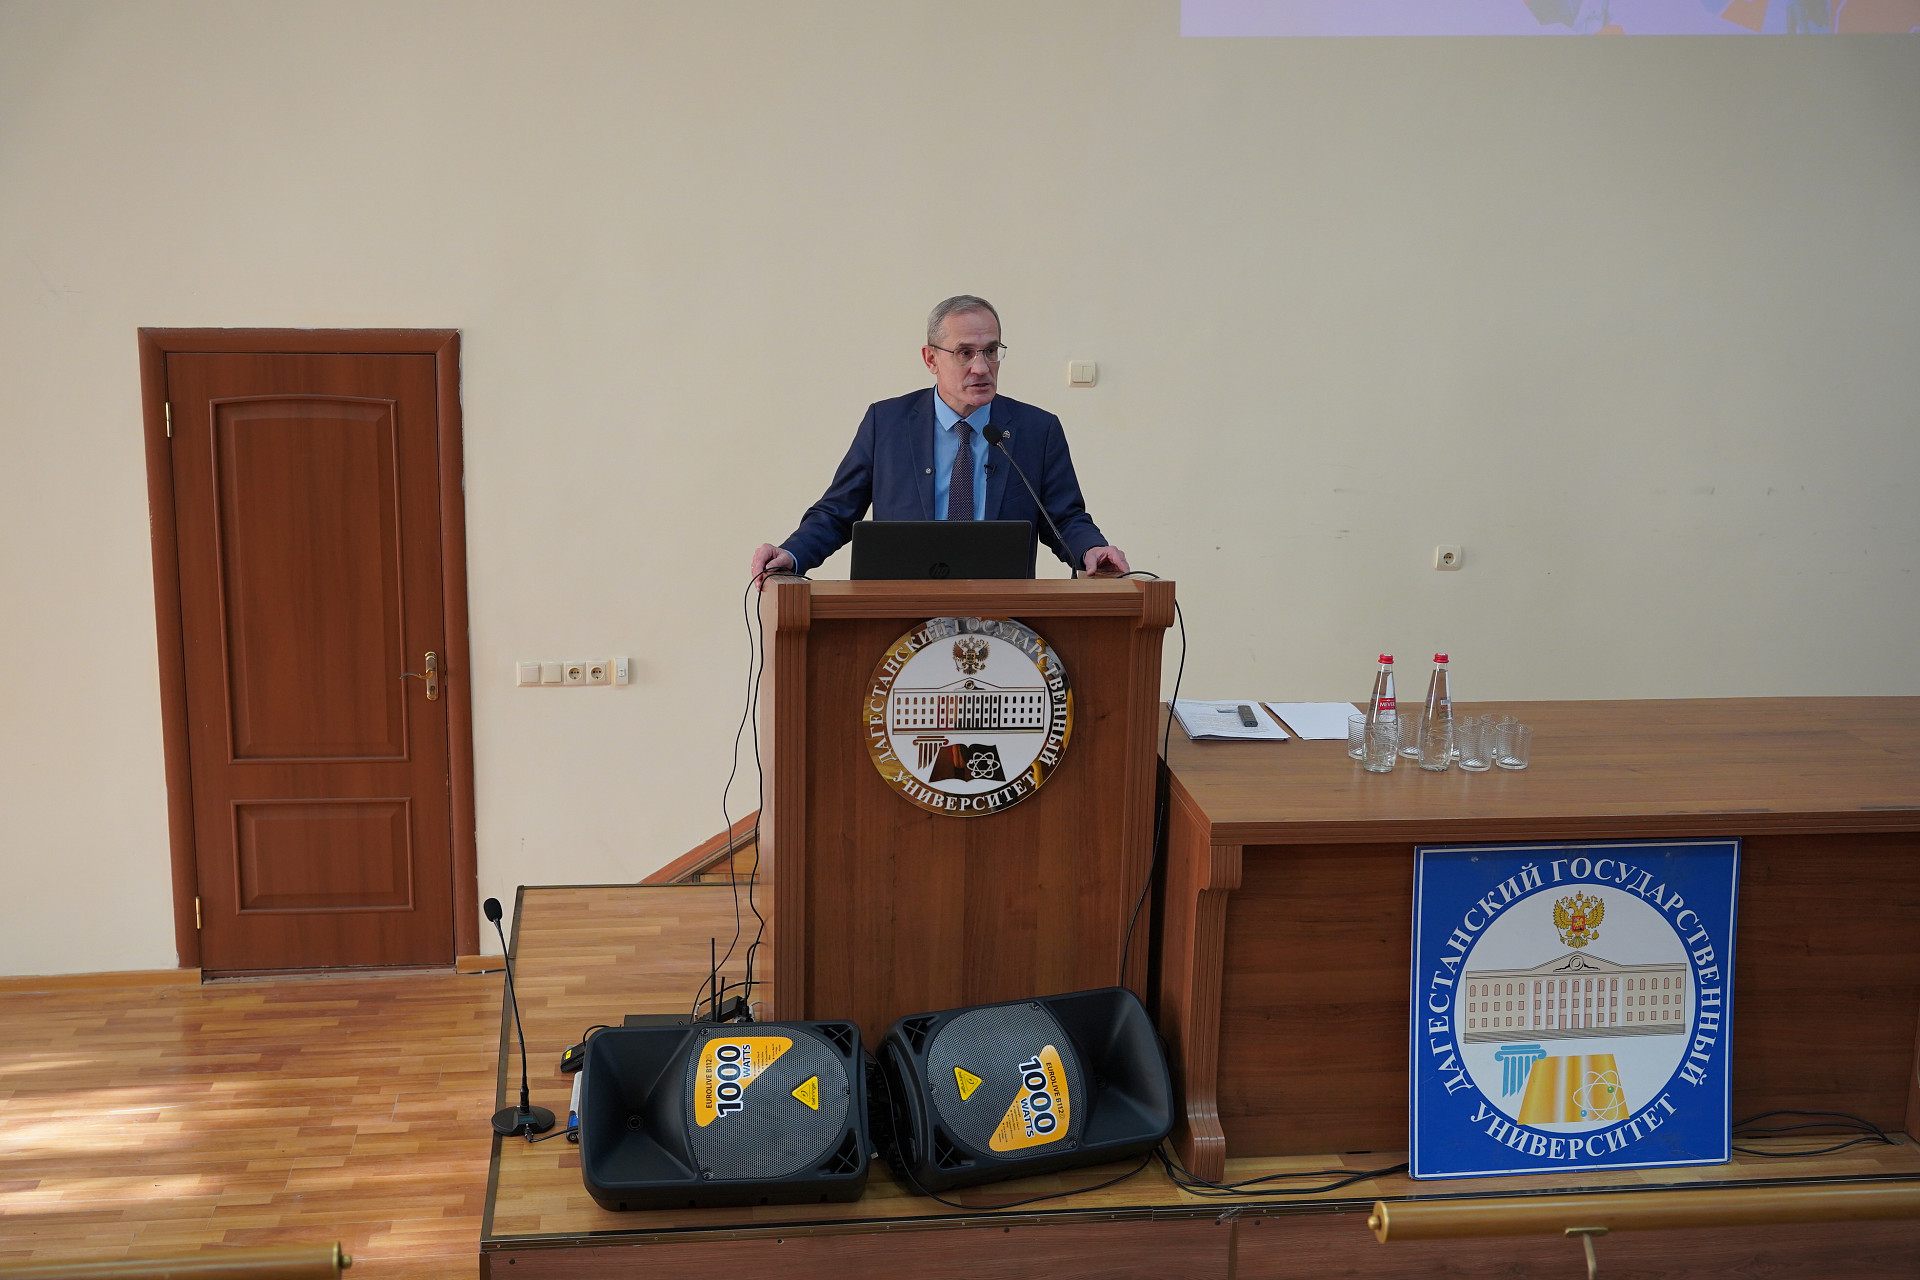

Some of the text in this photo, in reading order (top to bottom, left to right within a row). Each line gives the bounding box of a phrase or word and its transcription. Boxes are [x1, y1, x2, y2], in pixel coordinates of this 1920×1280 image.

[869, 617, 1068, 767] ДАГЕСТАНСКИЙ ГОСУДАРСТВЕННЫЙ
[893, 770, 1038, 812] УНИВЕРСИТЕТ
[1429, 857, 1721, 1096] ДАГЕСТАНСКИЙ ГОСУДАРСТВЕННЫЙ
[716, 1044, 743, 1117] 1000
[742, 1044, 752, 1078] WATTS
[1046, 1062, 1060, 1097] EUROLIVE
[1019, 1056, 1057, 1135] 1000
[1020, 1097, 1035, 1138] WATTS
[1470, 1093, 1678, 1160] УНИВЕРСИТЕТ
